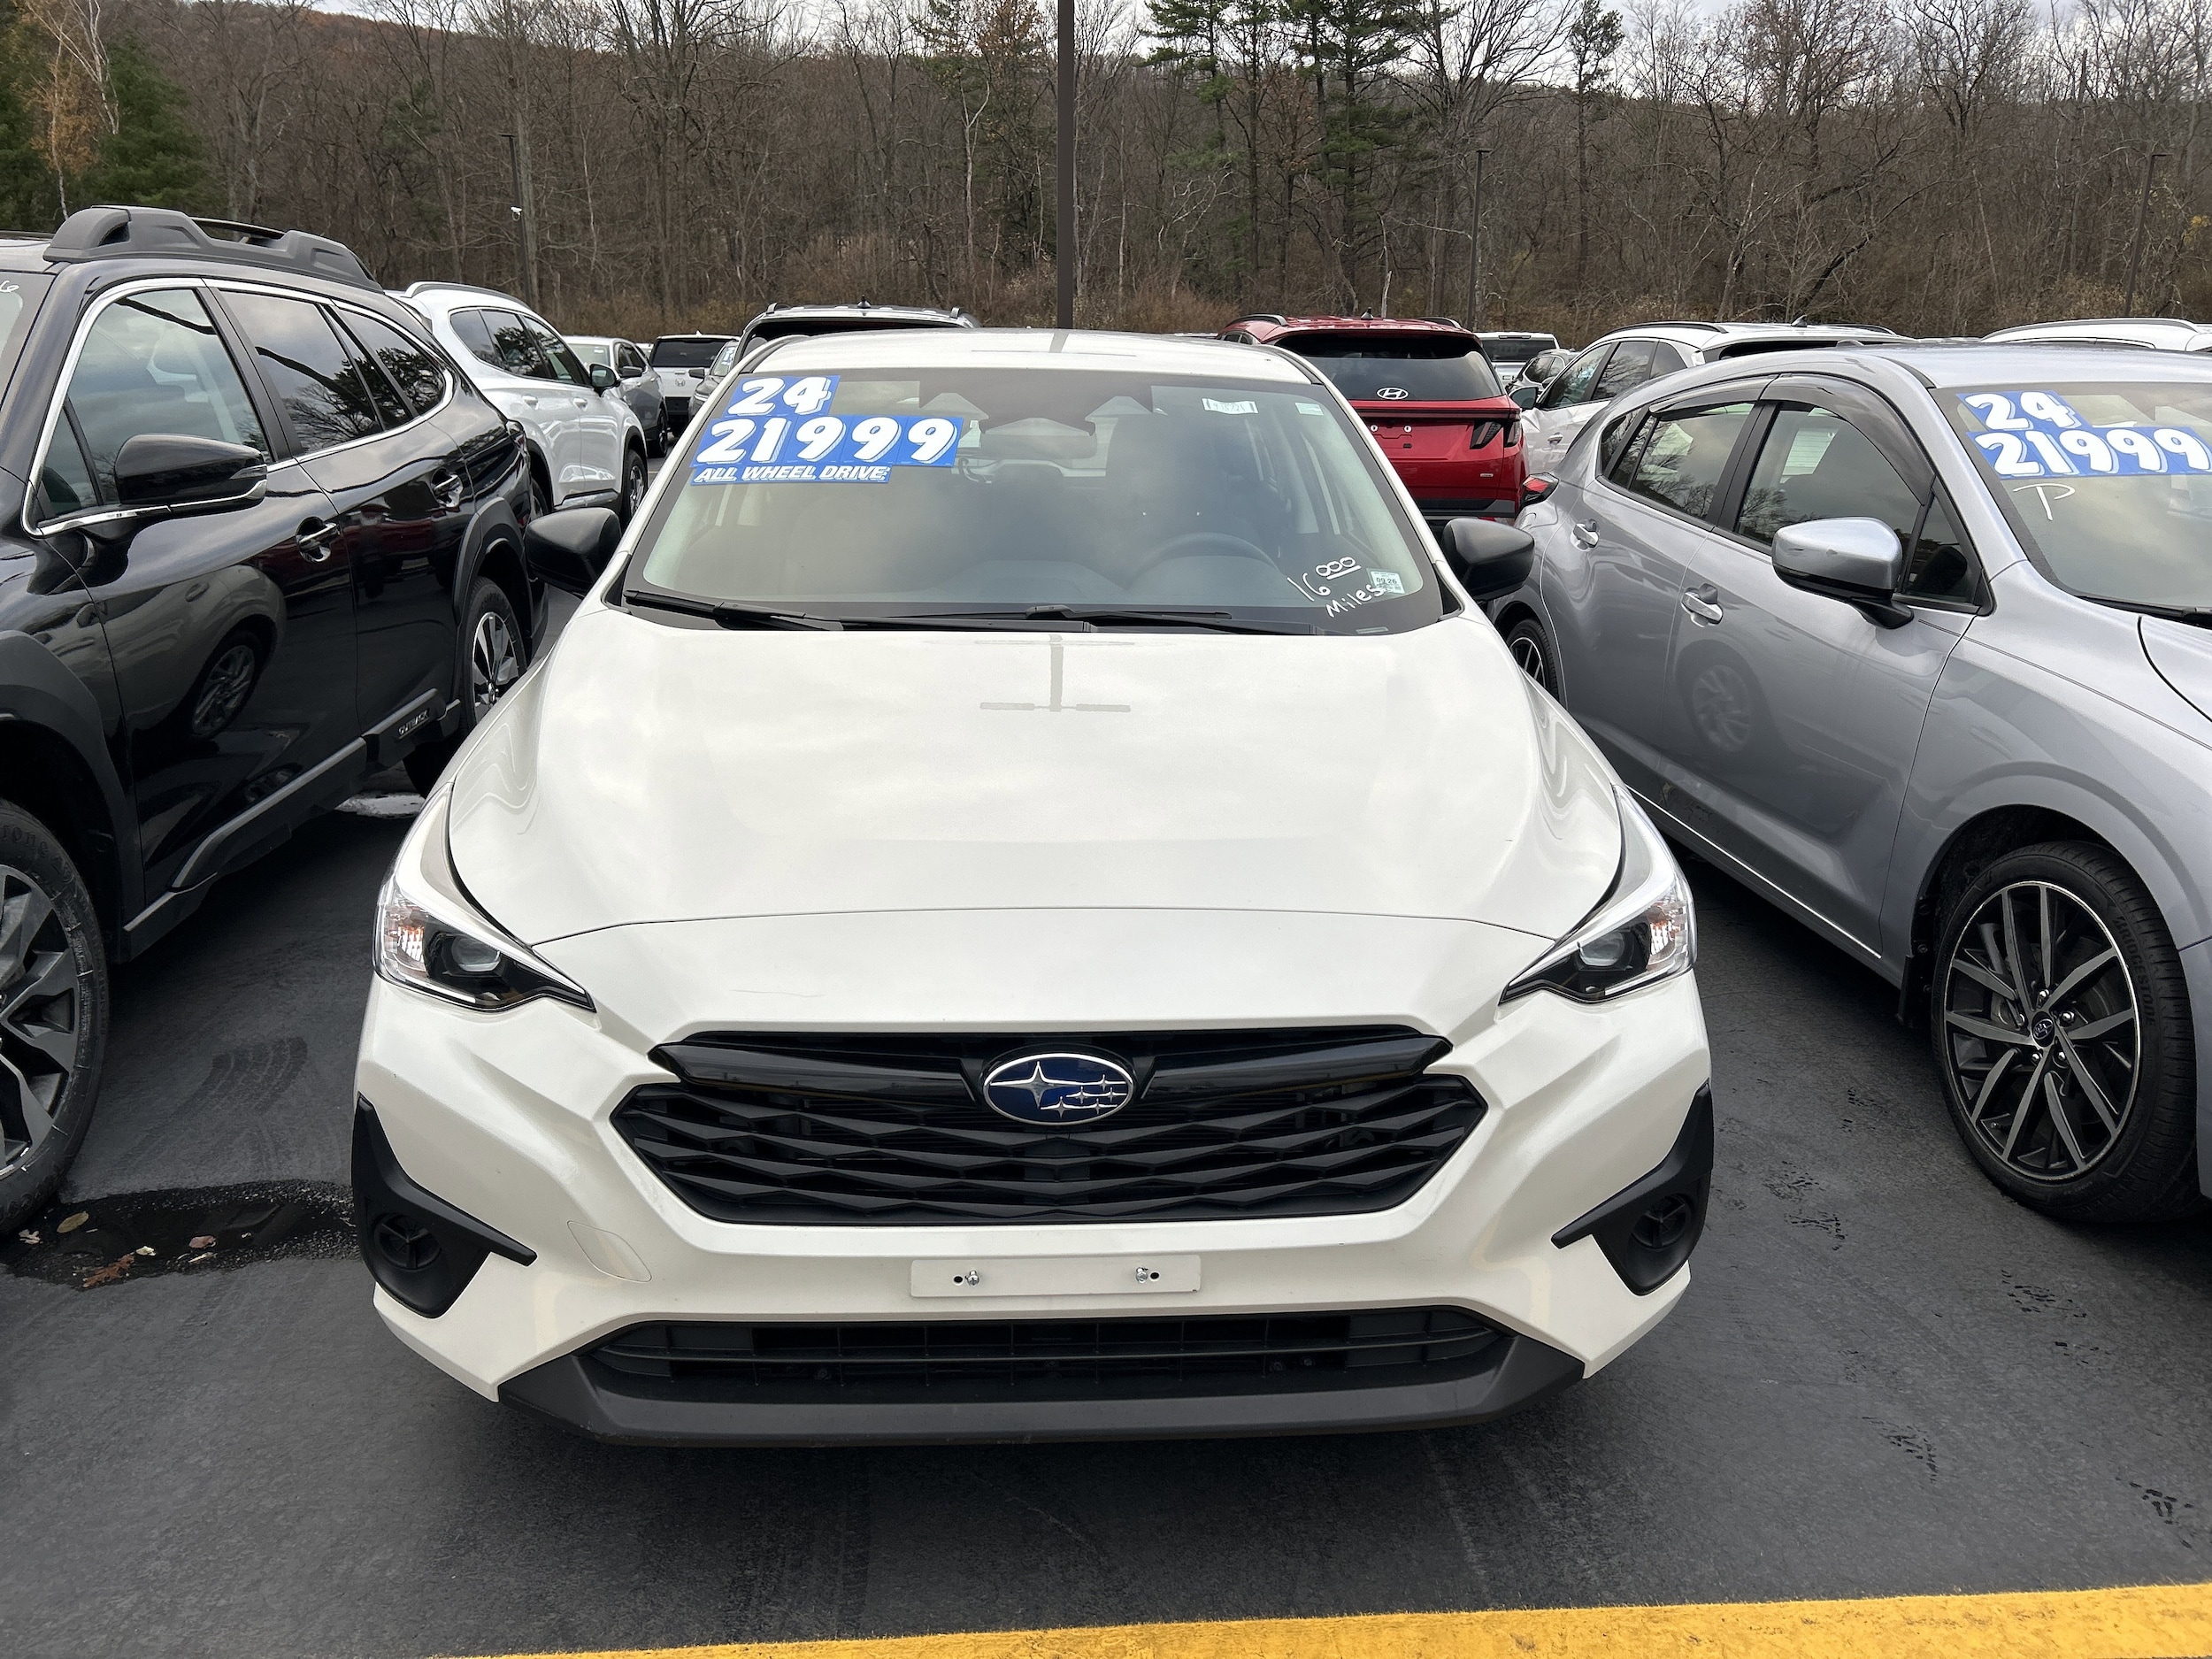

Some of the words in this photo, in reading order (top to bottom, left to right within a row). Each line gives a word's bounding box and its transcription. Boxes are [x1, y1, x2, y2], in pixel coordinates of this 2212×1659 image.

[726, 376, 833, 417] 24
[1964, 390, 2082, 431] 24
[695, 417, 959, 465] 21999
[1974, 427, 2212, 476] 21999
[693, 465, 737, 484] ALL
[740, 465, 818, 482] WHEEL
[818, 465, 889, 483] DRIVE
[2012, 483, 2076, 521] P
